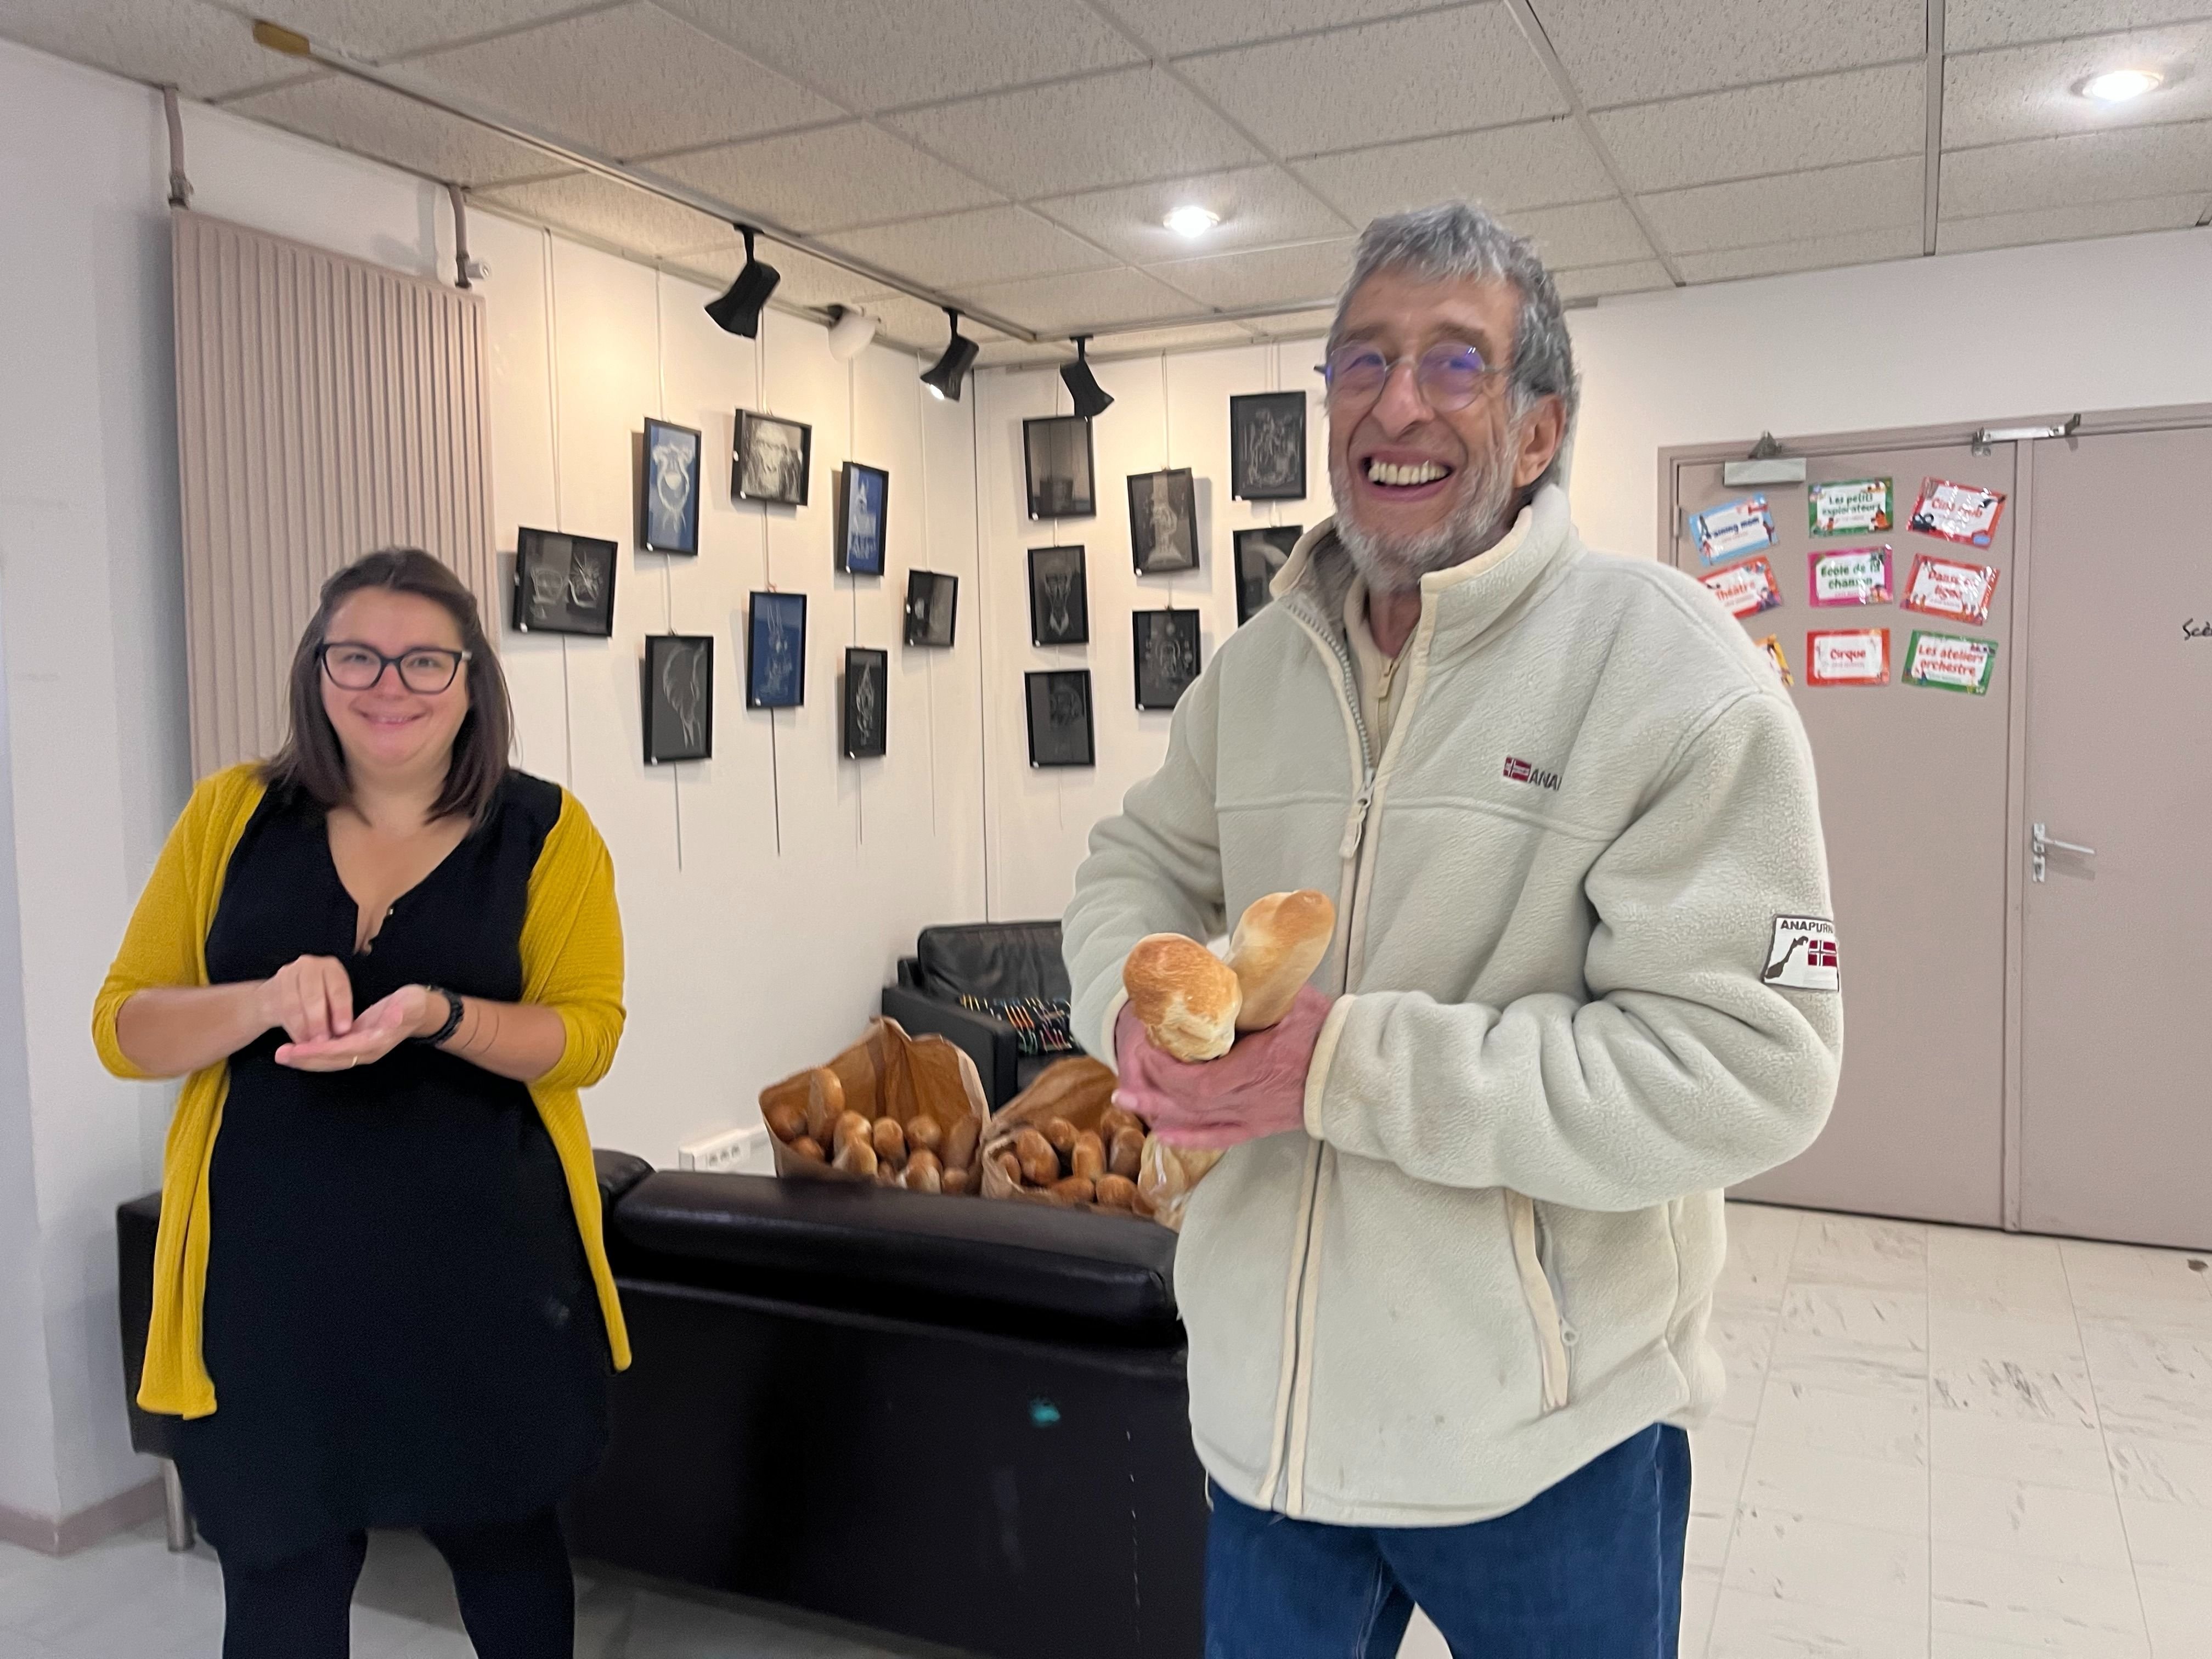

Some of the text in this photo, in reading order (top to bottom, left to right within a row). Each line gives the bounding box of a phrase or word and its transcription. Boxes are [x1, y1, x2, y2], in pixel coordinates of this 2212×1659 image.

[1829, 492, 1873, 506] Les petits
[1830, 649, 1866, 663] Cirque
[1918, 645, 1984, 662] Les ateliers
[1921, 659, 1976, 675] orchestre
